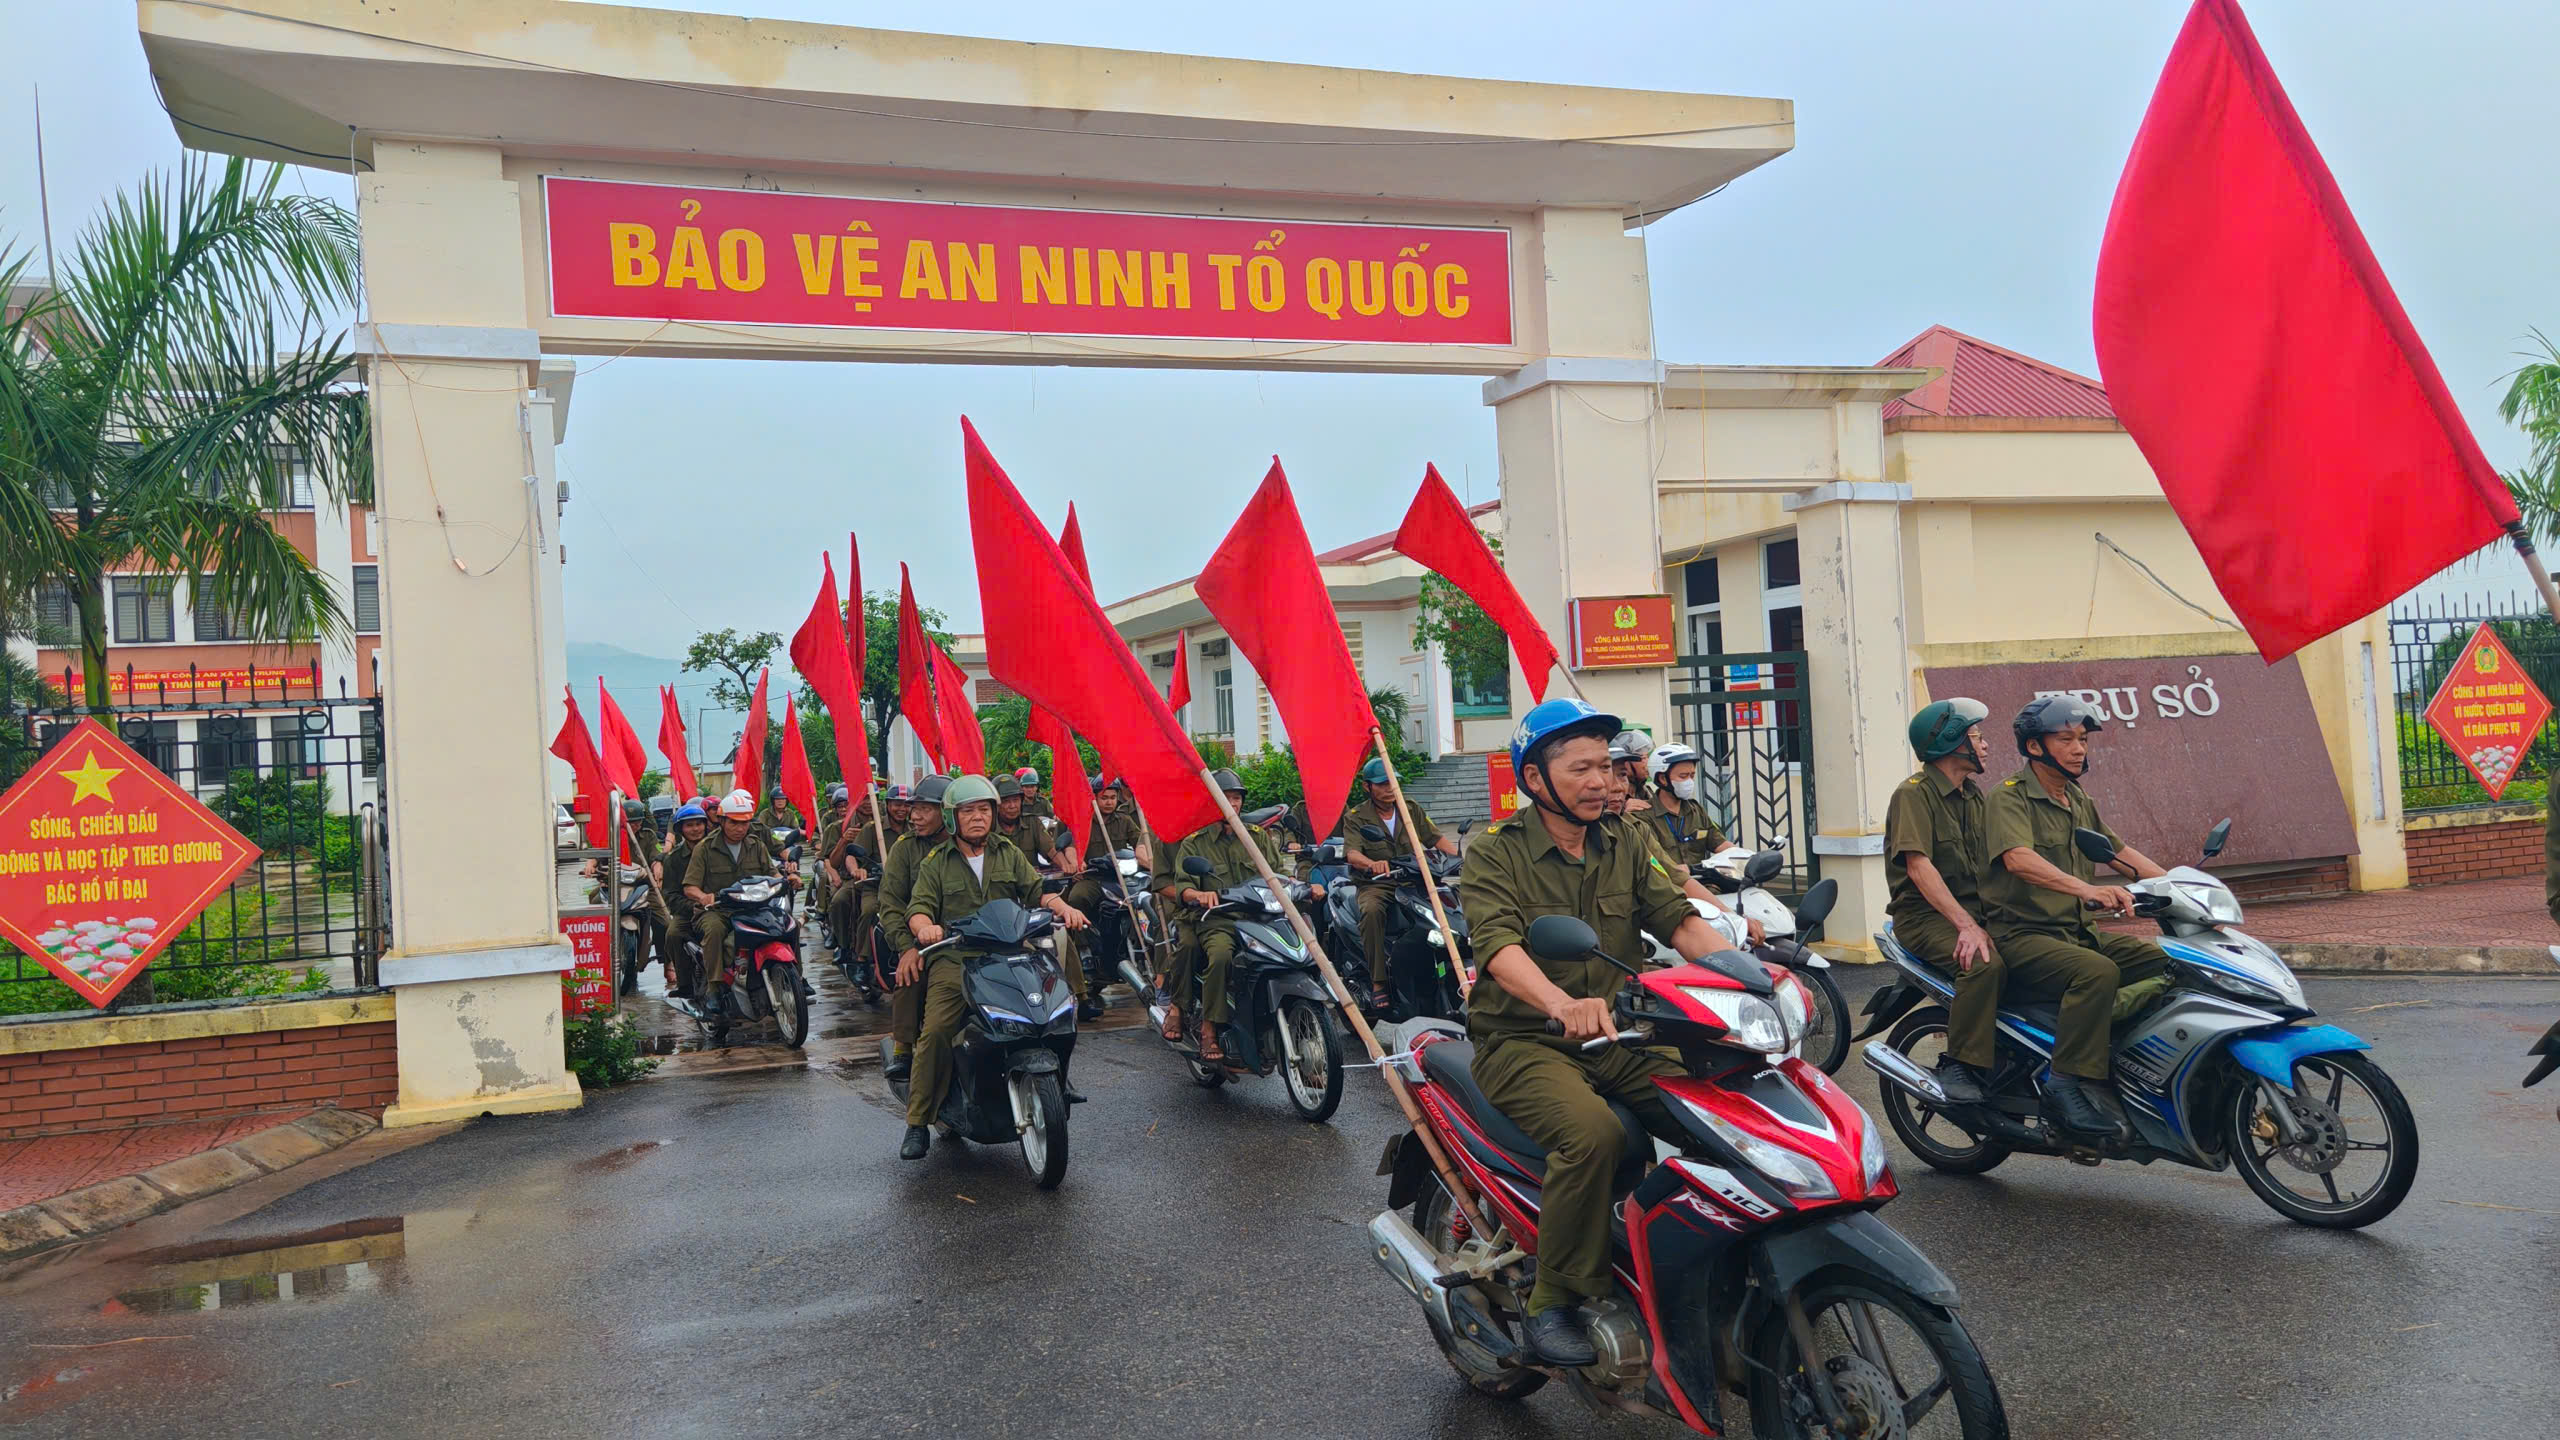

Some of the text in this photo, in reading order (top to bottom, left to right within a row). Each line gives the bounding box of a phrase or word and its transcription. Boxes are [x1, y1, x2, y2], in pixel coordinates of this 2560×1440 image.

[609, 199, 1470, 320] BẢO VỆ AN NINH TỔ QUỐC
[1595, 634, 1611, 644] CÔNG
[1622, 633, 1630, 643] XÃ
[1631, 633, 1639, 642] HÀ
[1640, 634, 1659, 642] TRUNG
[2034, 665, 2220, 728] RỤ SỞ
[30, 806, 158, 840] SỐNG, CHIẾN ĐẤU
[43, 847, 63, 872] VÀ
[67, 850, 97, 874] HỌC
[101, 844, 129, 872] TẬP
[133, 845, 169, 866] THEO
[173, 841, 223, 864] GƯƠNG
[46, 880, 77, 904] BÁC
[104, 876, 119, 900] VĨ
[123, 878, 147, 903] ĐẠI
[566, 920, 606, 934] XUỐNG
[578, 938, 593, 949] XE
